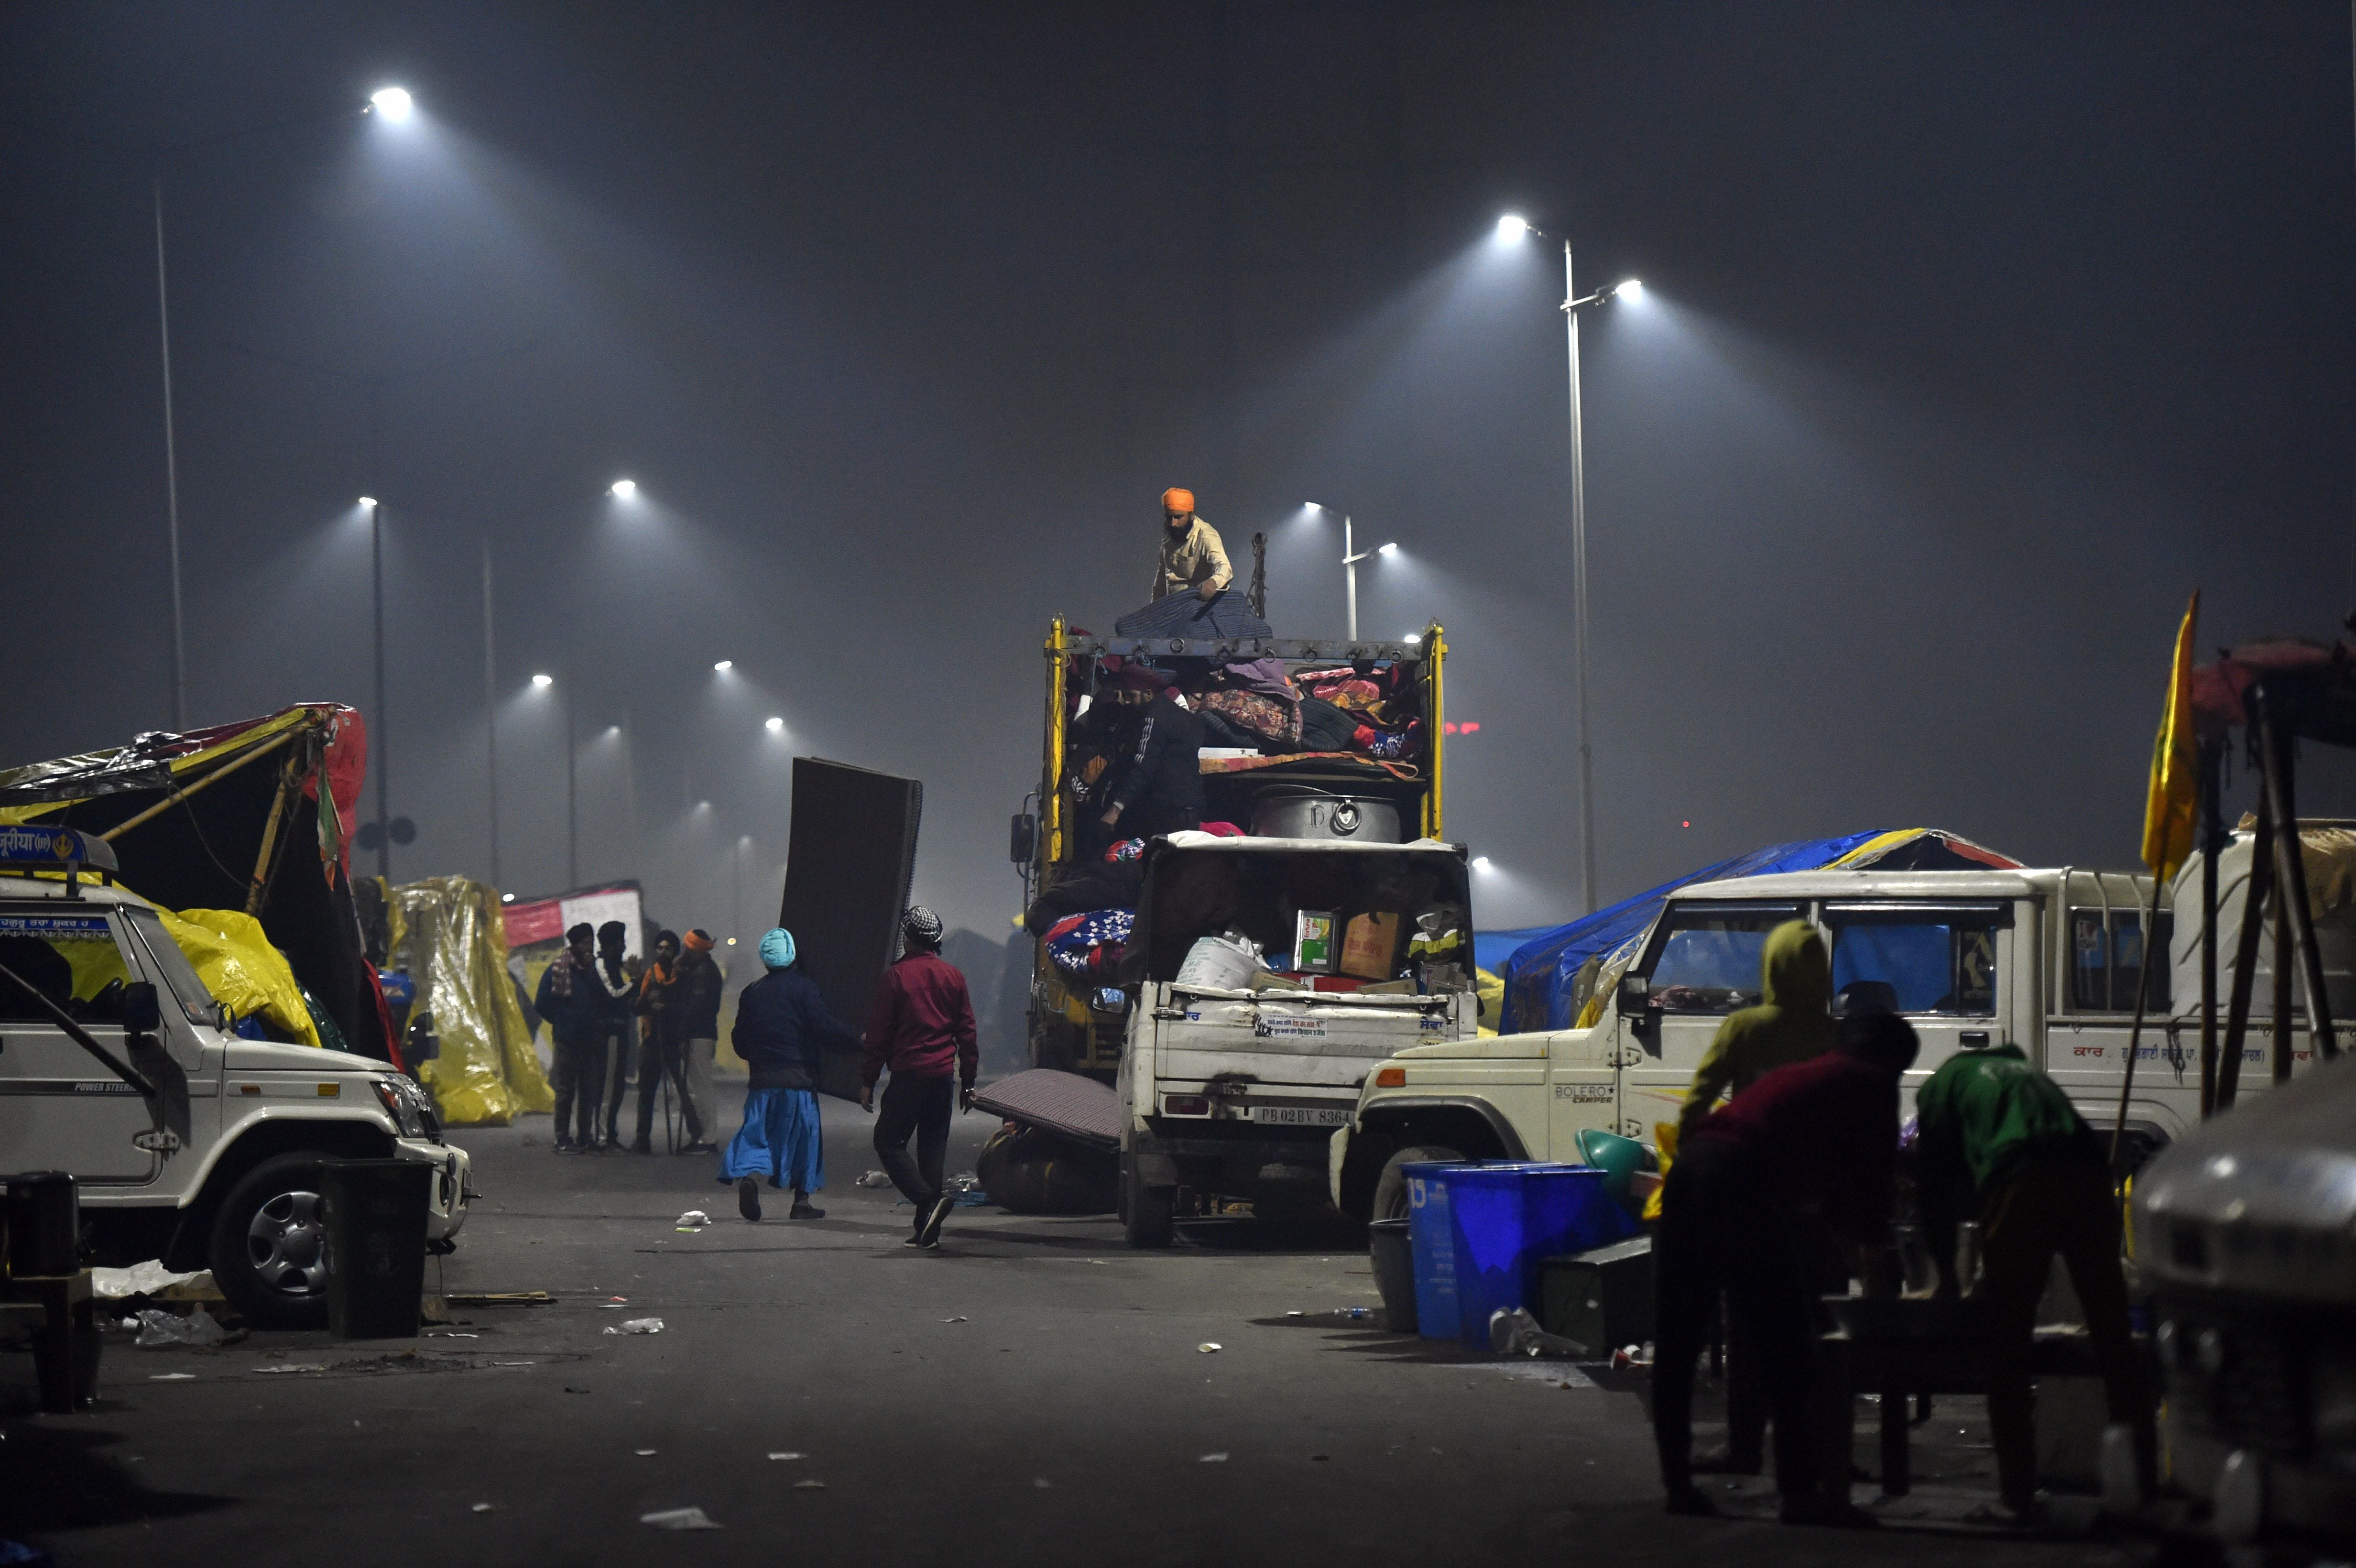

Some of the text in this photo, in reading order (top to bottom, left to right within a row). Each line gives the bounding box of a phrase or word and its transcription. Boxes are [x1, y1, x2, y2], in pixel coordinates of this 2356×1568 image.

[75, 1083, 105, 1092] POWER
[1555, 1086, 1606, 1097] BOLERO
[1262, 1109, 1277, 1122] PB
[1319, 1111, 1350, 1123] 8364
